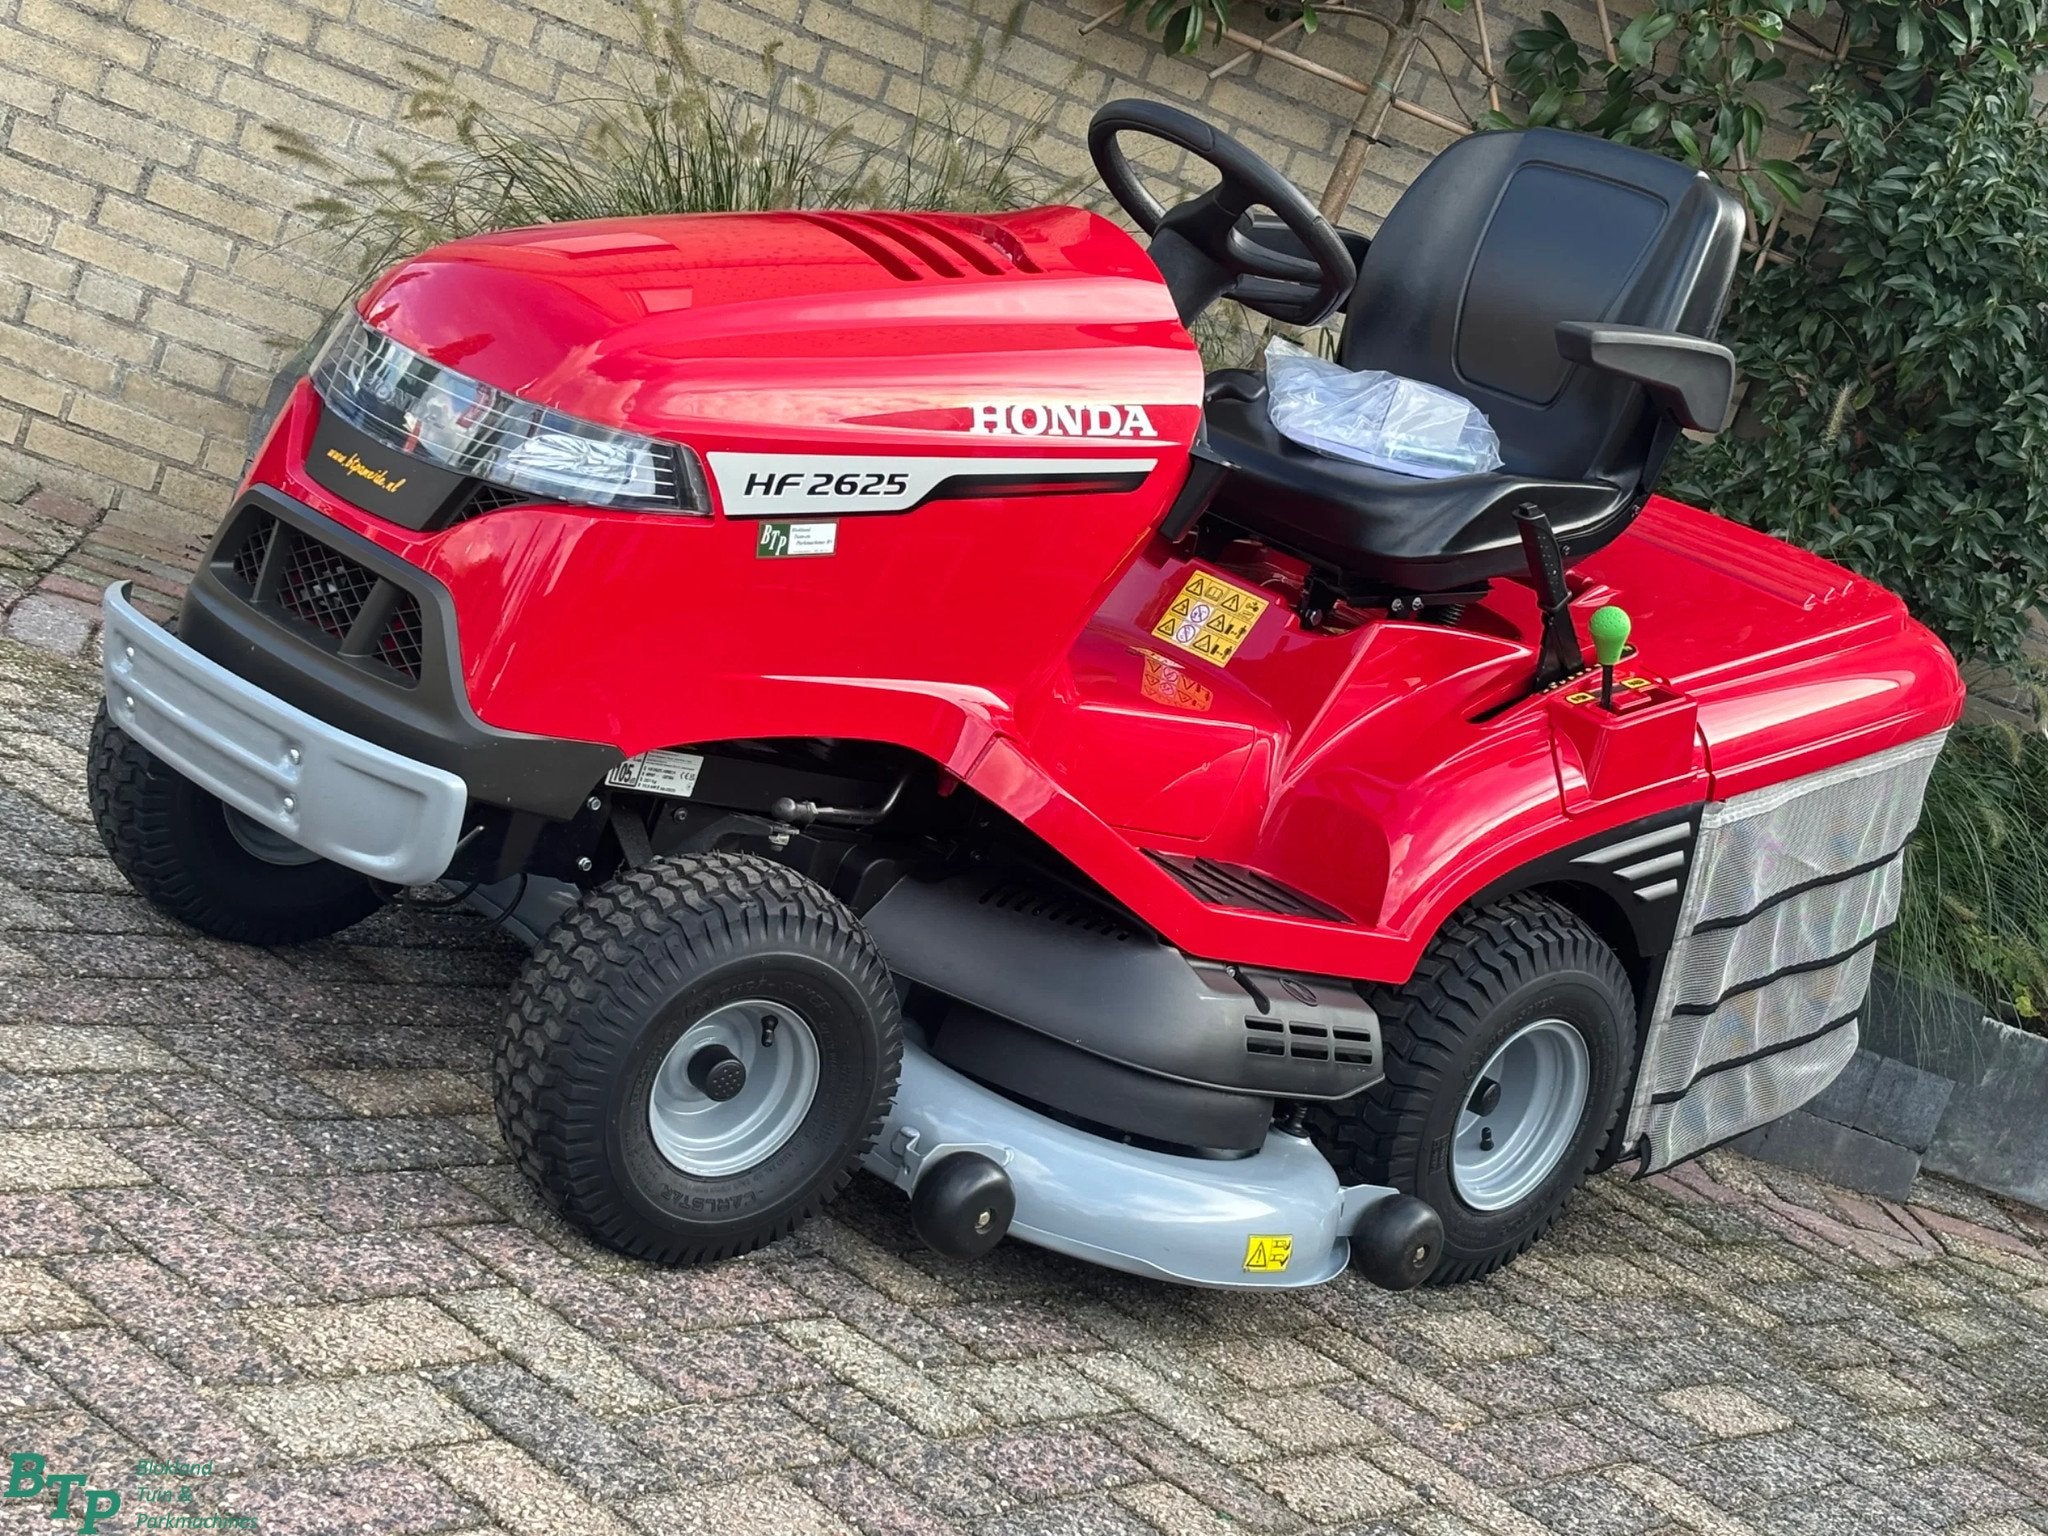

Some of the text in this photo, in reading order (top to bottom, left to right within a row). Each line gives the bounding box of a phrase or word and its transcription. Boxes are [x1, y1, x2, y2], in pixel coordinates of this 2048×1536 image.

[969, 402, 1158, 437] HONDA
[744, 473, 909, 496] HF 2625
[760, 524, 787, 556] BTP
[660, 1183, 757, 1213] CARLSTAR
